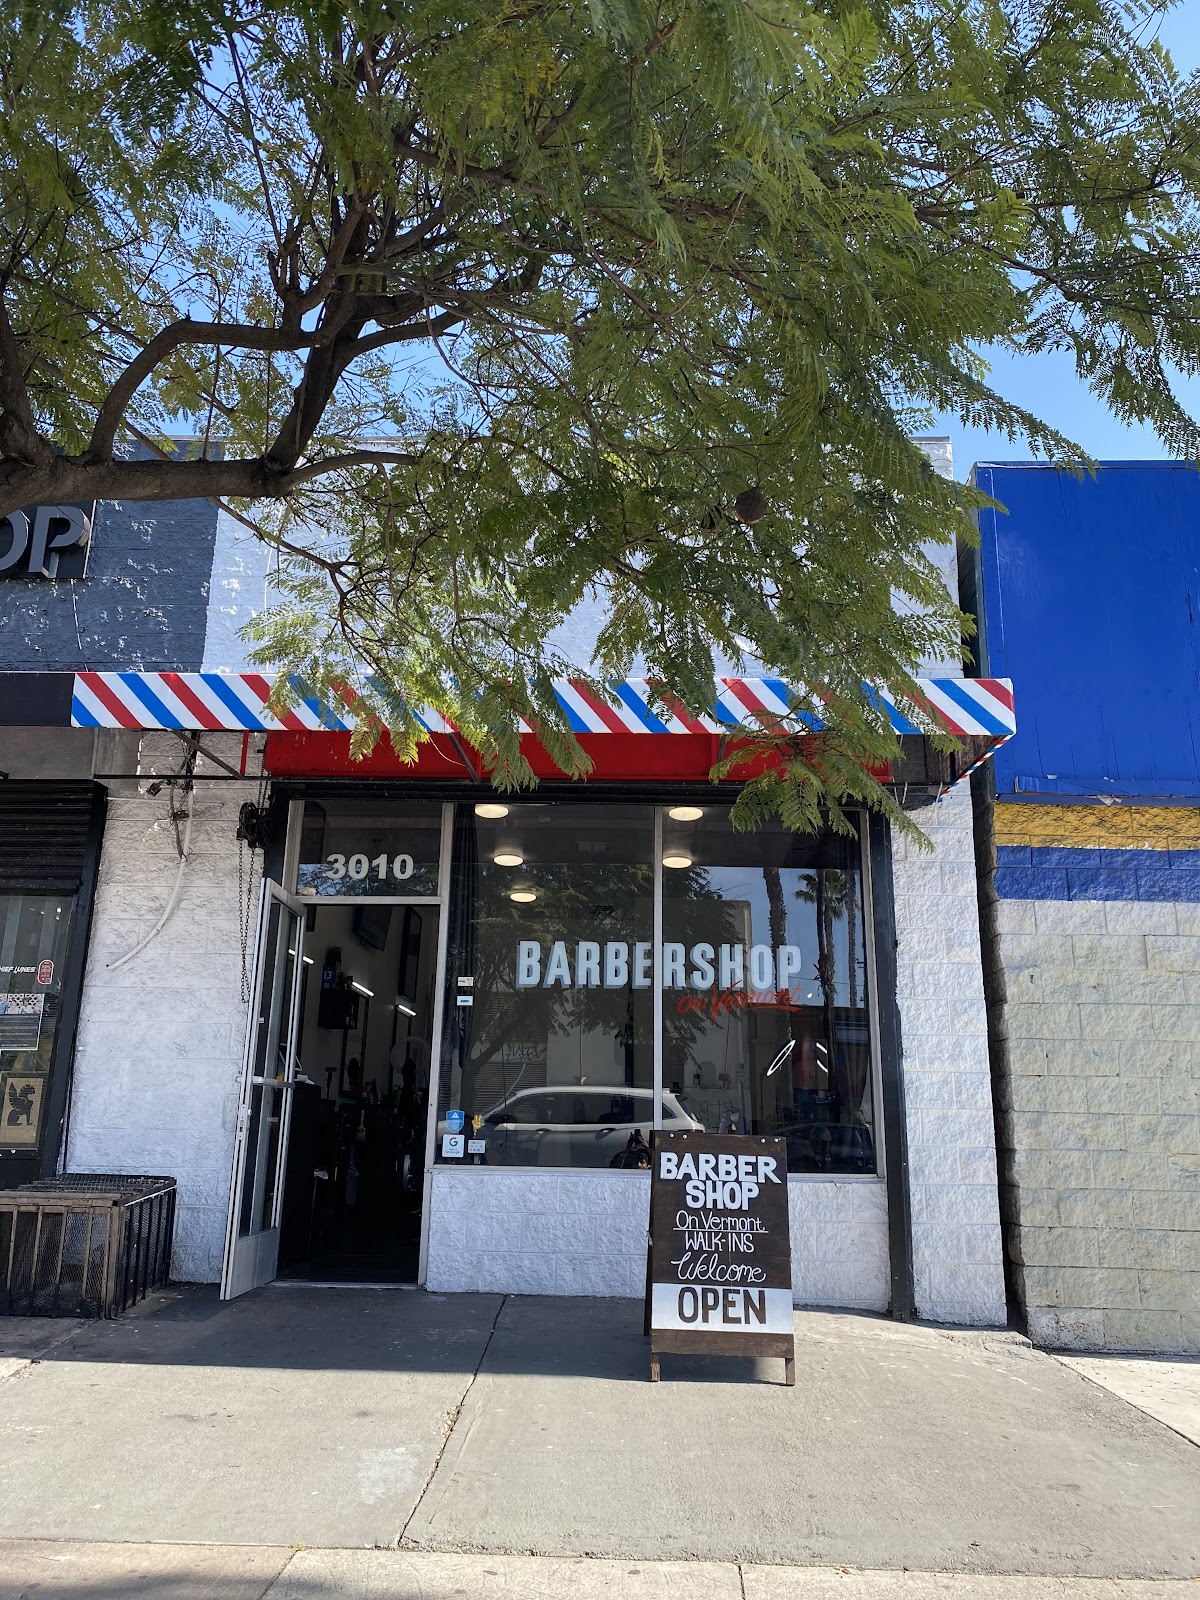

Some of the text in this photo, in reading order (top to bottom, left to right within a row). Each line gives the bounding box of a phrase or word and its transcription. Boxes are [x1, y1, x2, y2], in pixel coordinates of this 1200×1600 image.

[326, 853, 414, 880] 3010
[515, 940, 802, 990] BARBERSHOP
[710, 980, 802, 1021] Vermont
[660, 1152, 782, 1184] BARBER
[686, 1180, 760, 1211] SHOP
[676, 1209, 699, 1230] On
[685, 1231, 755, 1253] WALK-INS
[670, 1251, 767, 1283] Welcome
[678, 1286, 767, 1325] OPEN
